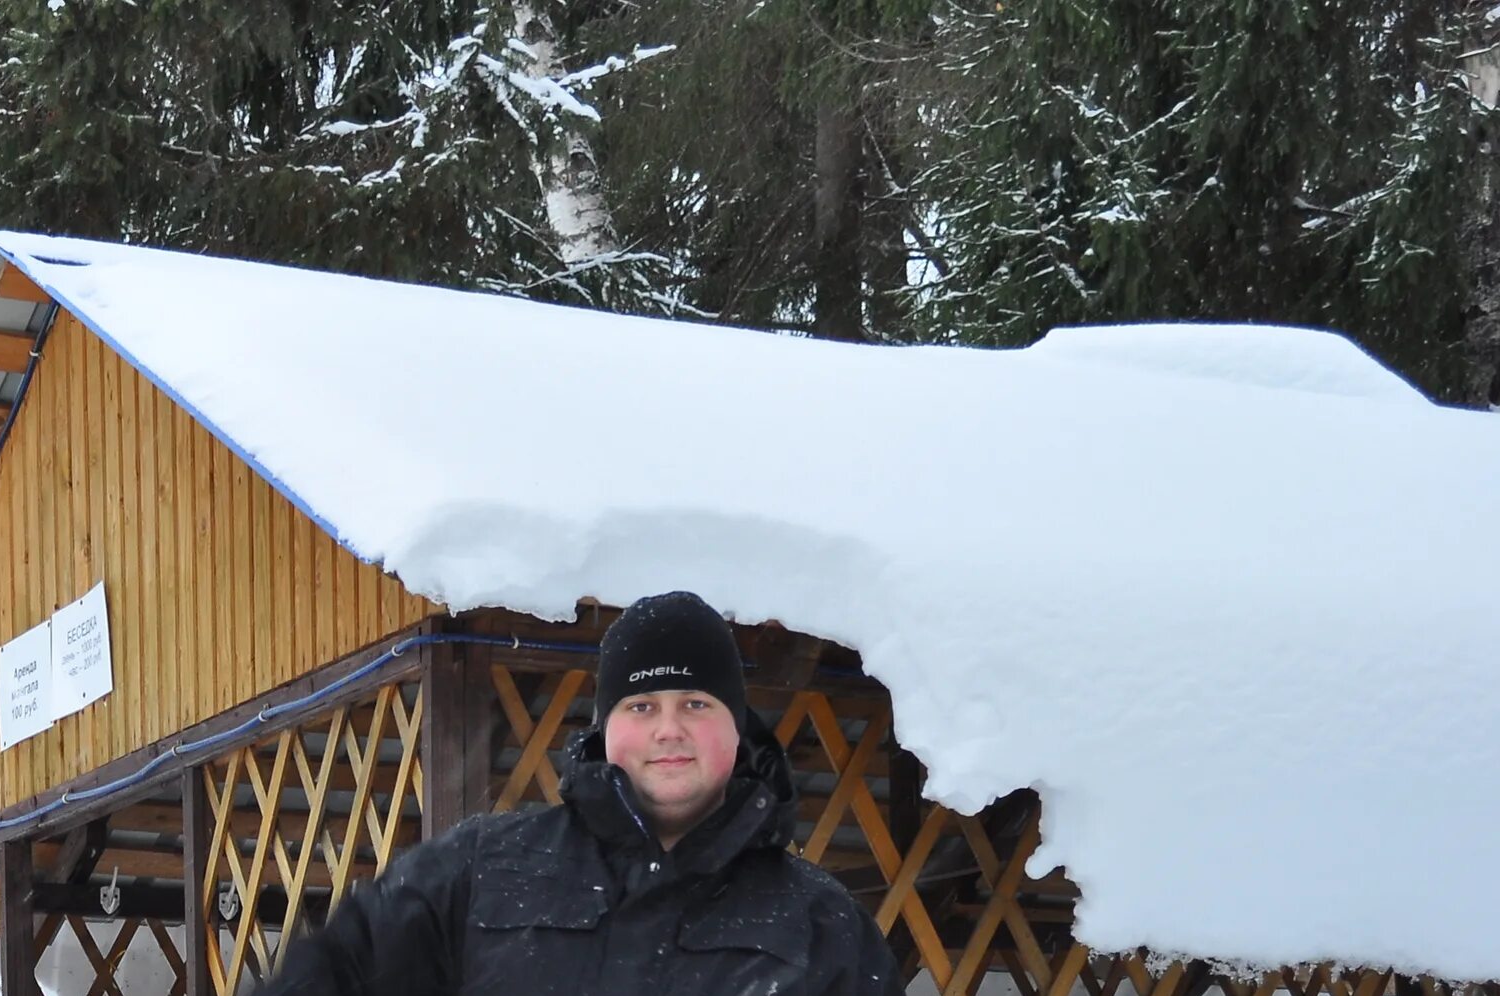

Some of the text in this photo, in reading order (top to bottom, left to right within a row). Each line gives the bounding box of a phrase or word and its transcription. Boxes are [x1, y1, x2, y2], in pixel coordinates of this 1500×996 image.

[67, 616, 97, 645] БЕСЕДКА
[14, 660, 38, 682] Аренда
[11, 703, 23, 721] 100
